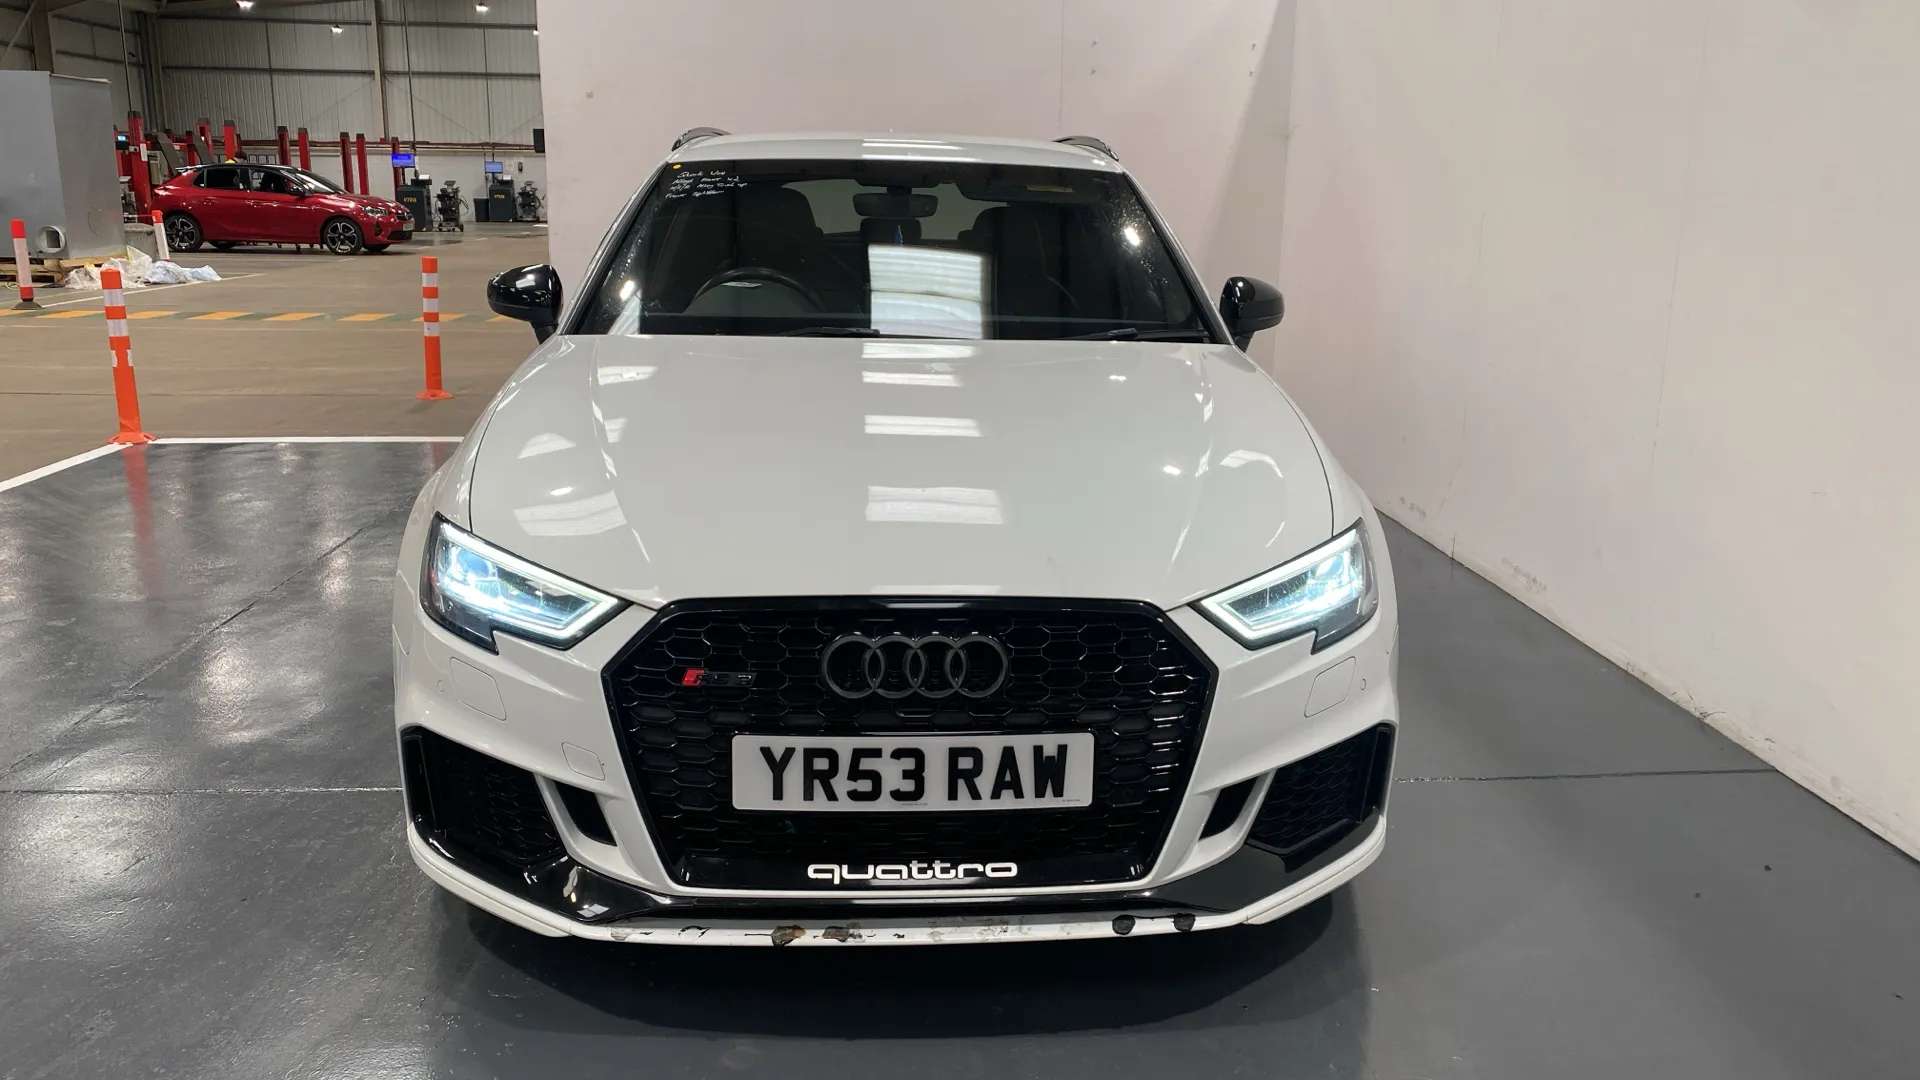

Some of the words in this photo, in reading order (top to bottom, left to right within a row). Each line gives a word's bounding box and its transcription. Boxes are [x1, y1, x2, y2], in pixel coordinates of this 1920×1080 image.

[759, 746, 926, 802] YR53
[947, 744, 1068, 801] RAW
[807, 860, 1018, 885] quattro
